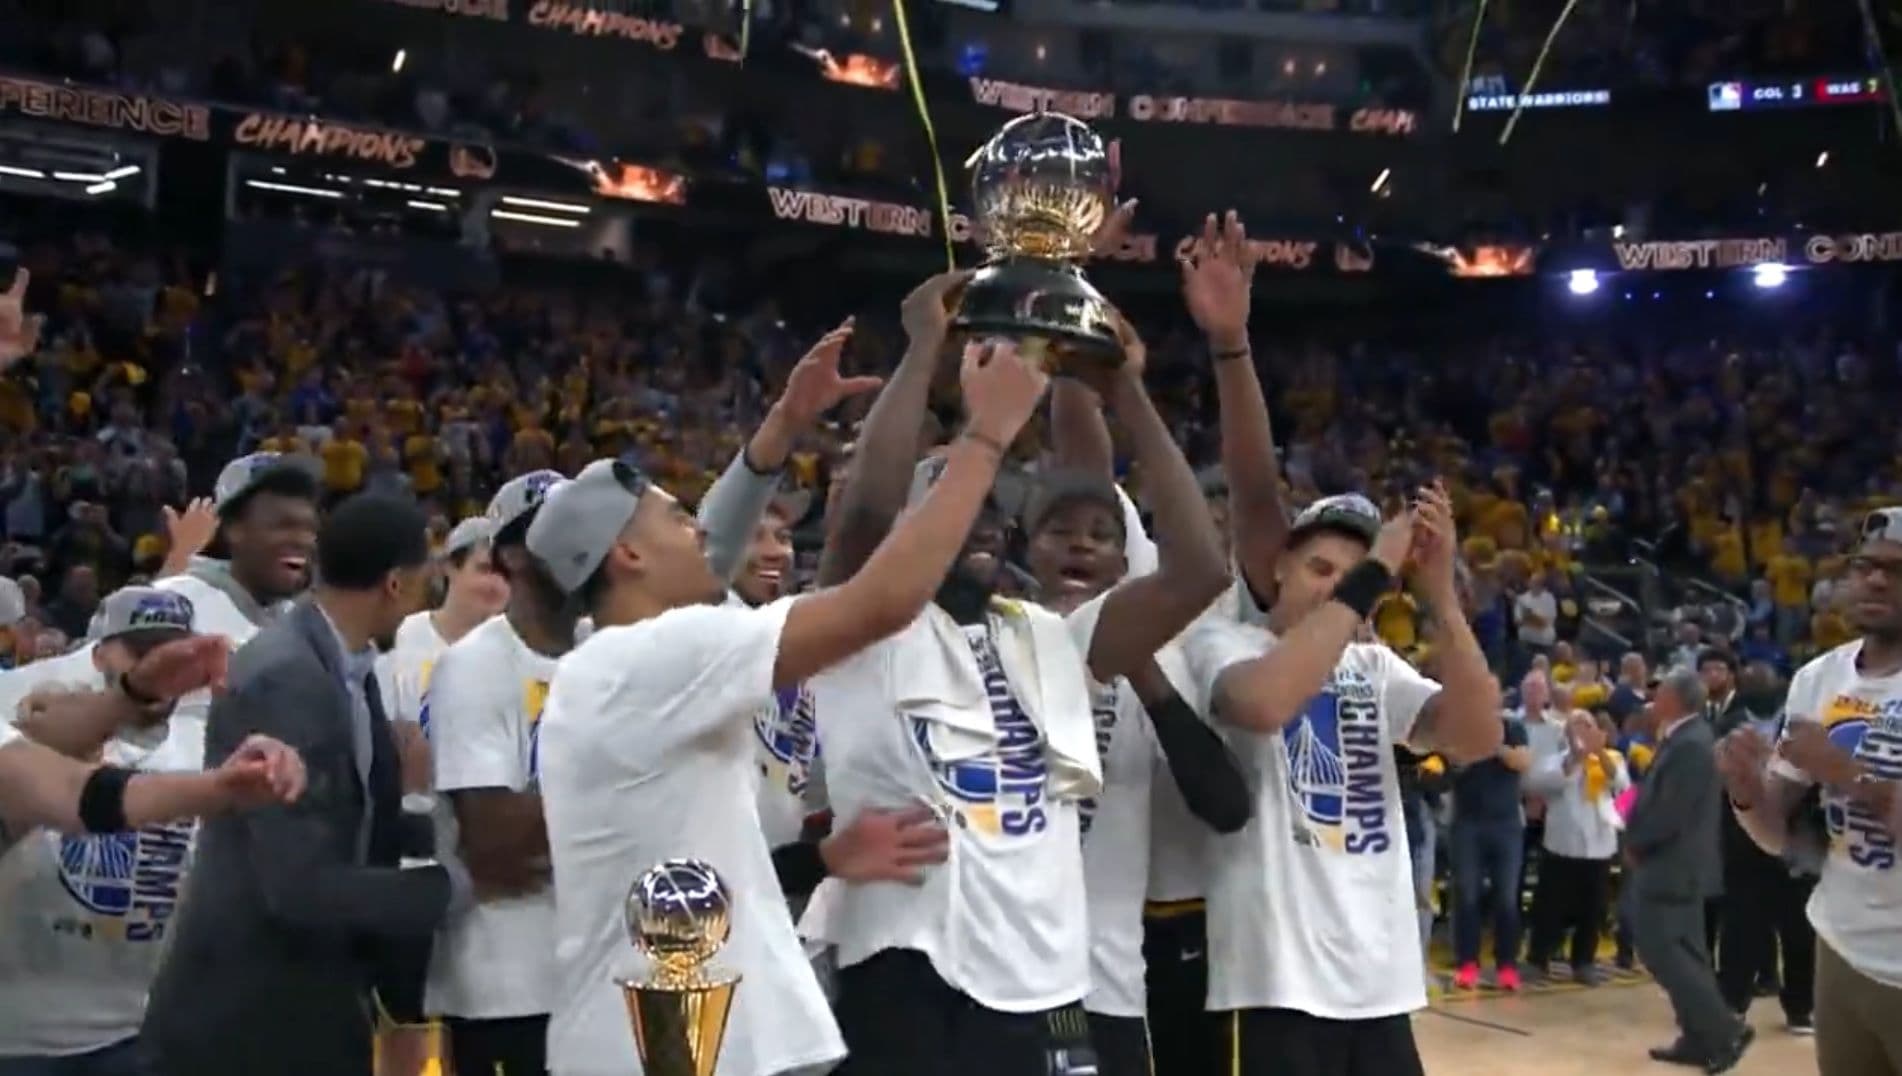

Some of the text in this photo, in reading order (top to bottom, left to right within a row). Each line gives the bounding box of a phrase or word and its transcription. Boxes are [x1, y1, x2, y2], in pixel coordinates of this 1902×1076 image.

[529, 0, 683, 49] CHAMPIONS
[1469, 96, 1515, 111] STATE
[1753, 86, 1784, 100] COL
[234, 113, 425, 168] CHAMPIONS
[767, 186, 932, 237] WESTERN
[1614, 238, 1786, 270] WESTERN
[1338, 701, 1390, 855] CHAMPS
